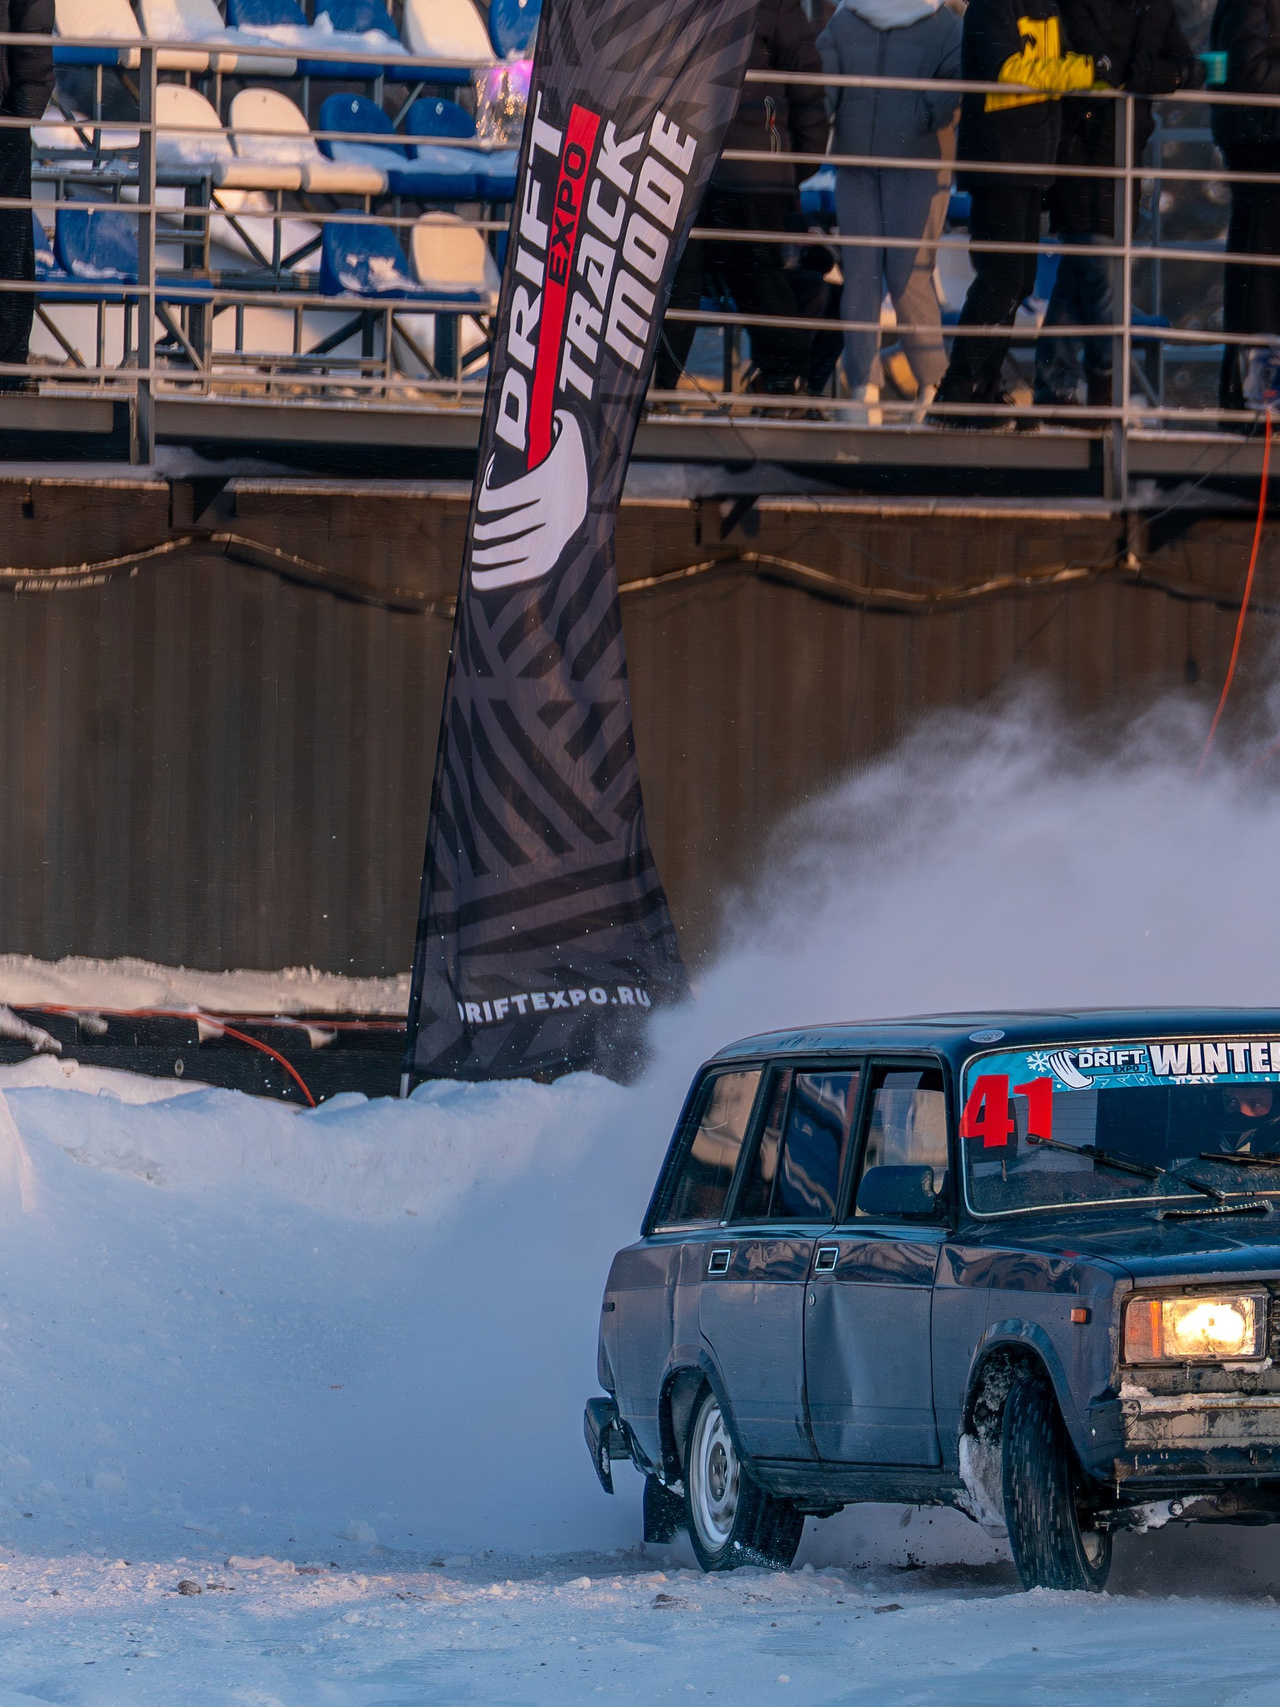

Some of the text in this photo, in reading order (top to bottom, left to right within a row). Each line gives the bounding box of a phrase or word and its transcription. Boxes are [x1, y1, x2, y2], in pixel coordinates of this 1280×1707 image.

[495, 90, 562, 451] DRIFT
[548, 142, 586, 286] EXPO
[559, 119, 645, 400] TRACK
[605, 110, 697, 370] MODE
[959, 1074, 1053, 1148] 41
[1078, 1050, 1144, 1068] DRIFT
[1112, 1065, 1139, 1073] EXPO
